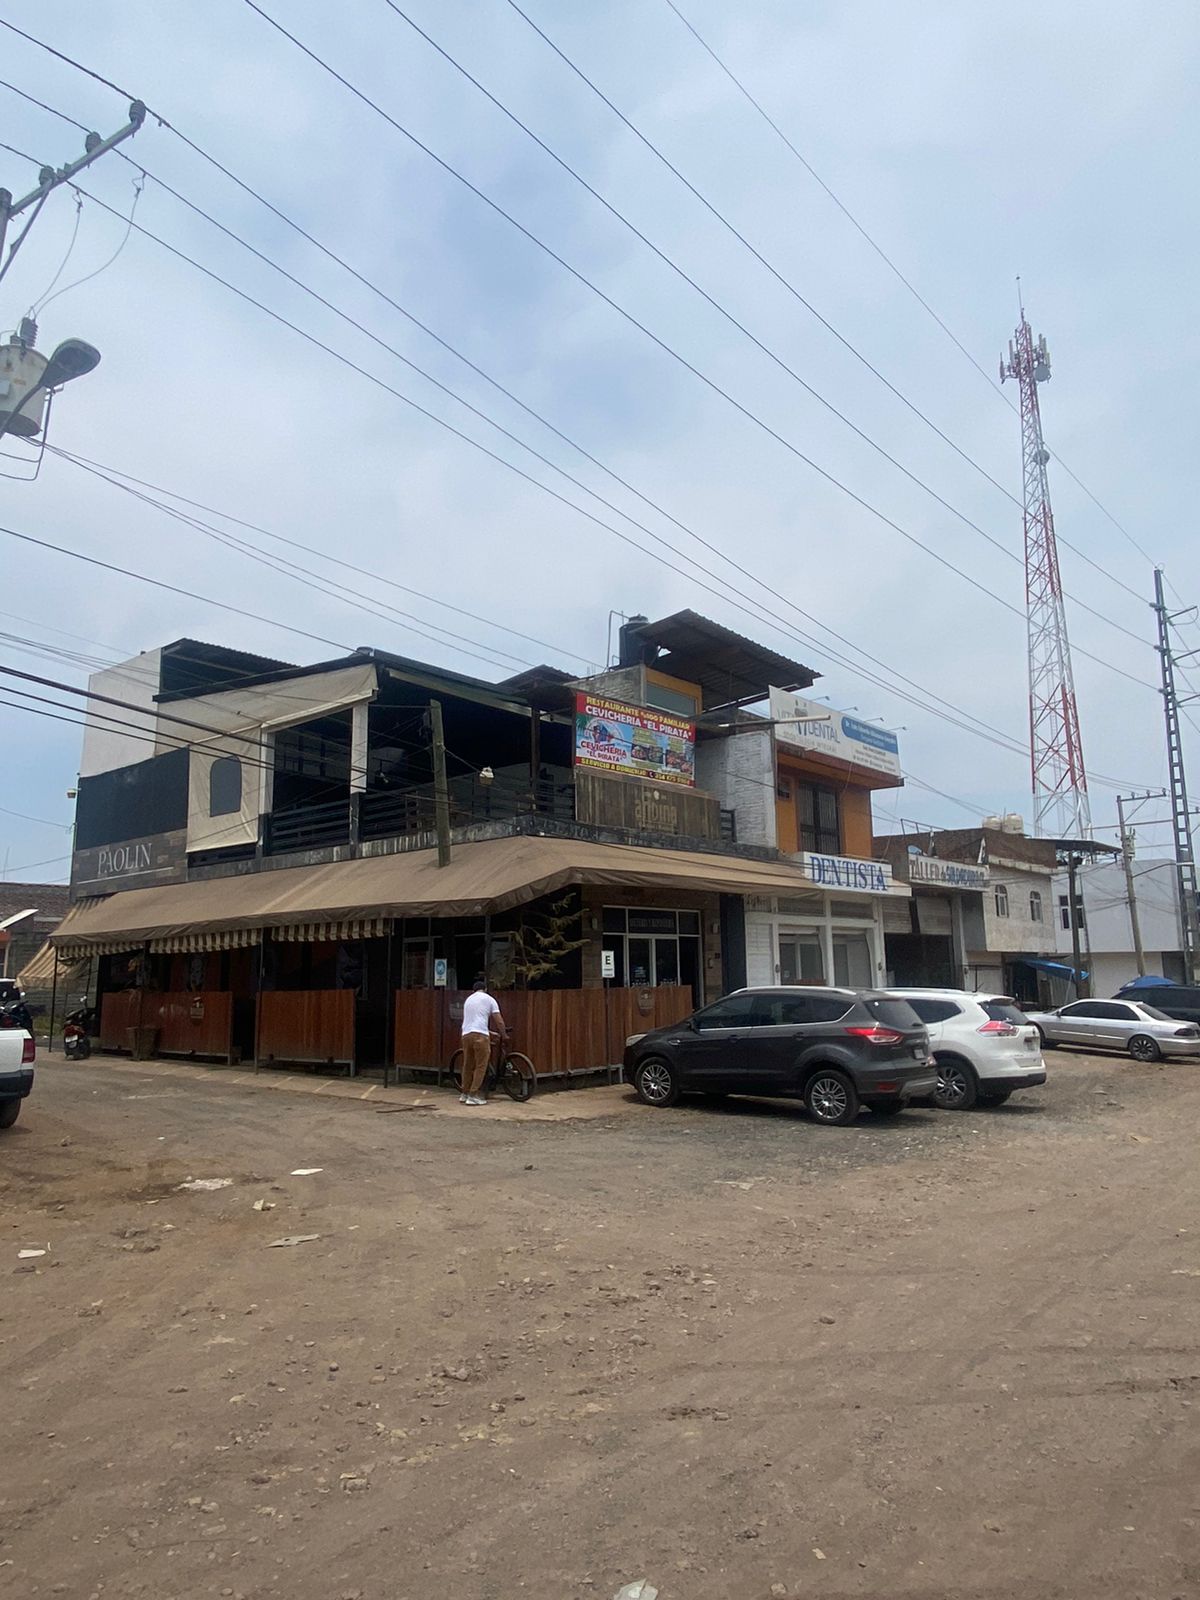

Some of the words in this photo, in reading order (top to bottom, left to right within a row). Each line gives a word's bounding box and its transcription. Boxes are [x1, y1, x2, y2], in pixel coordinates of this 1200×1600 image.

[585, 705, 642, 727] CEVICHERIA
[586, 696, 640, 716] RESTAURANTE
[659, 716, 690, 729] FAMILIAR
[581, 740, 627, 757] CEVICHERIA
[581, 757, 611, 770] SERVICIO
[611, 762, 616, 771] A
[98, 843, 152, 874] PAOLIN
[909, 857, 940, 880] TALLER
[810, 856, 888, 891] DENTISTA
[605, 955, 611, 965] E
